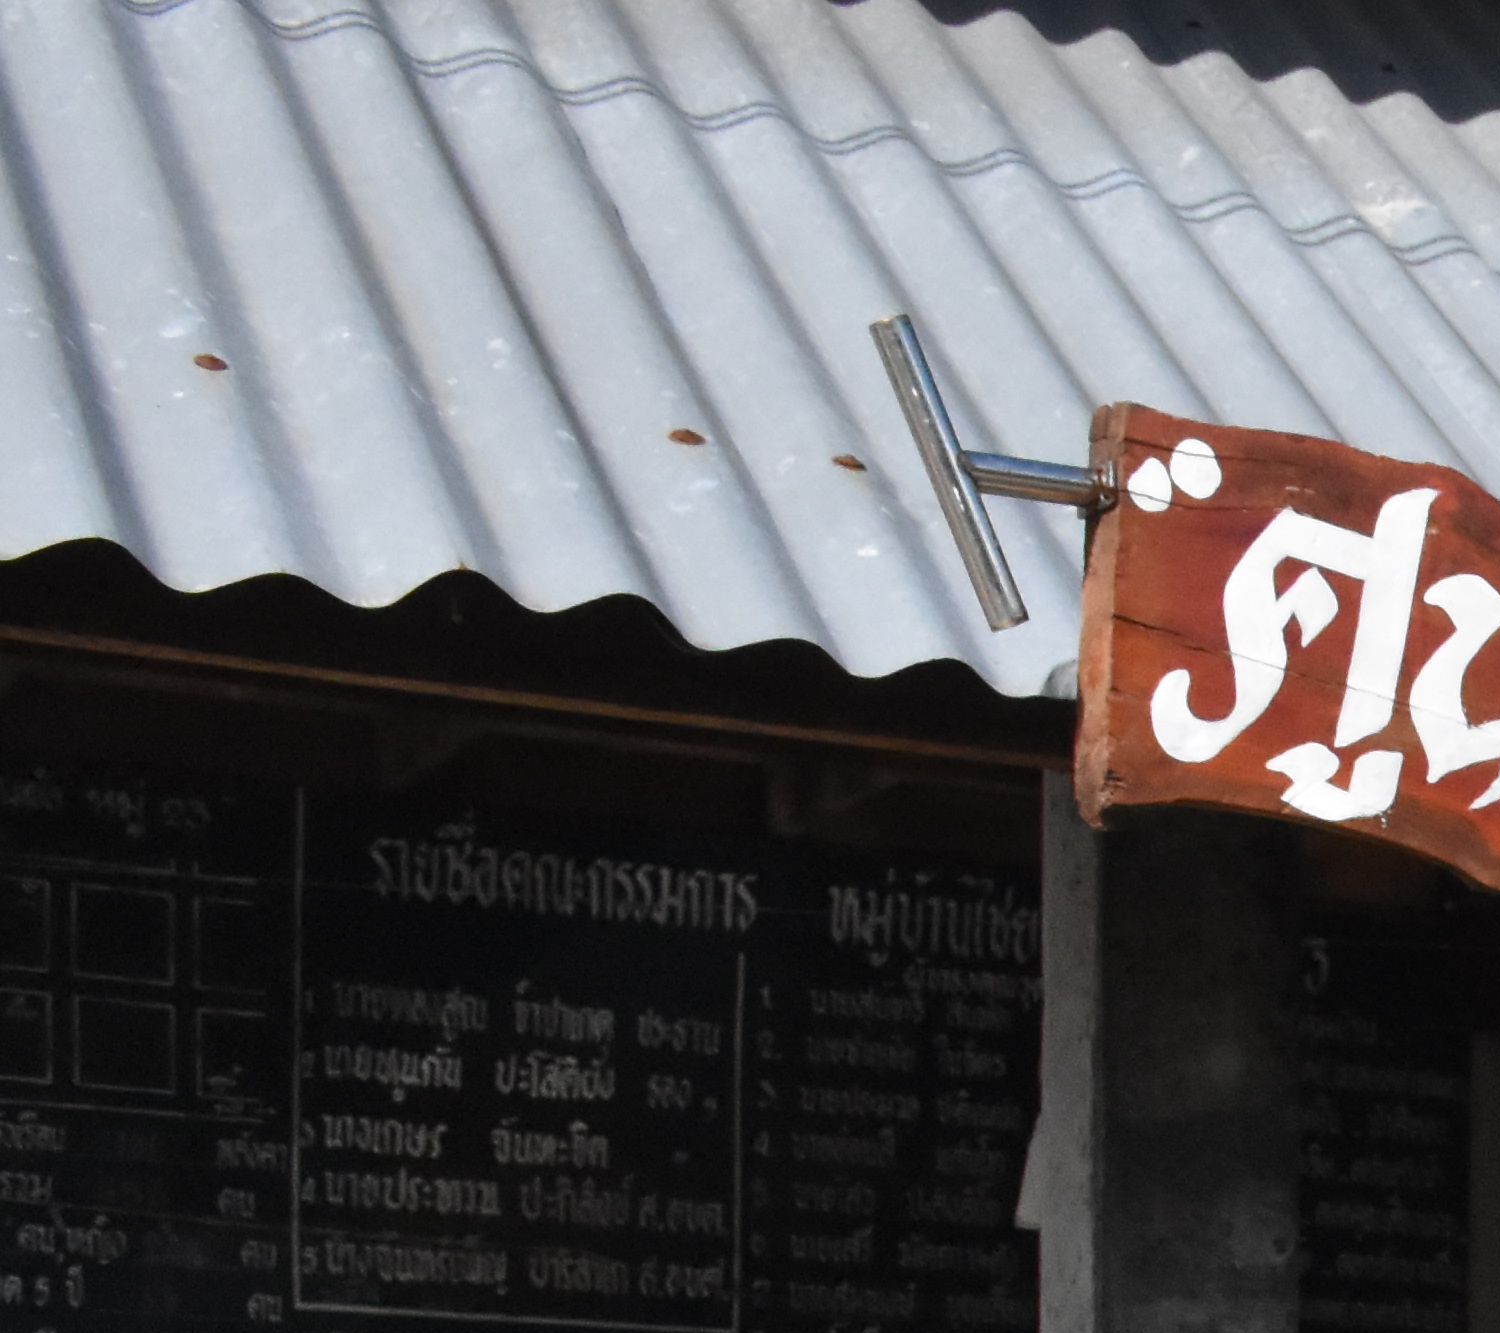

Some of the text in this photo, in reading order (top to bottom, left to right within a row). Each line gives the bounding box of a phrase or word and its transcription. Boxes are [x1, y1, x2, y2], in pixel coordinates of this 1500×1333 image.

[368, 806, 758, 932] รายชื่อคณะกรรมการ
